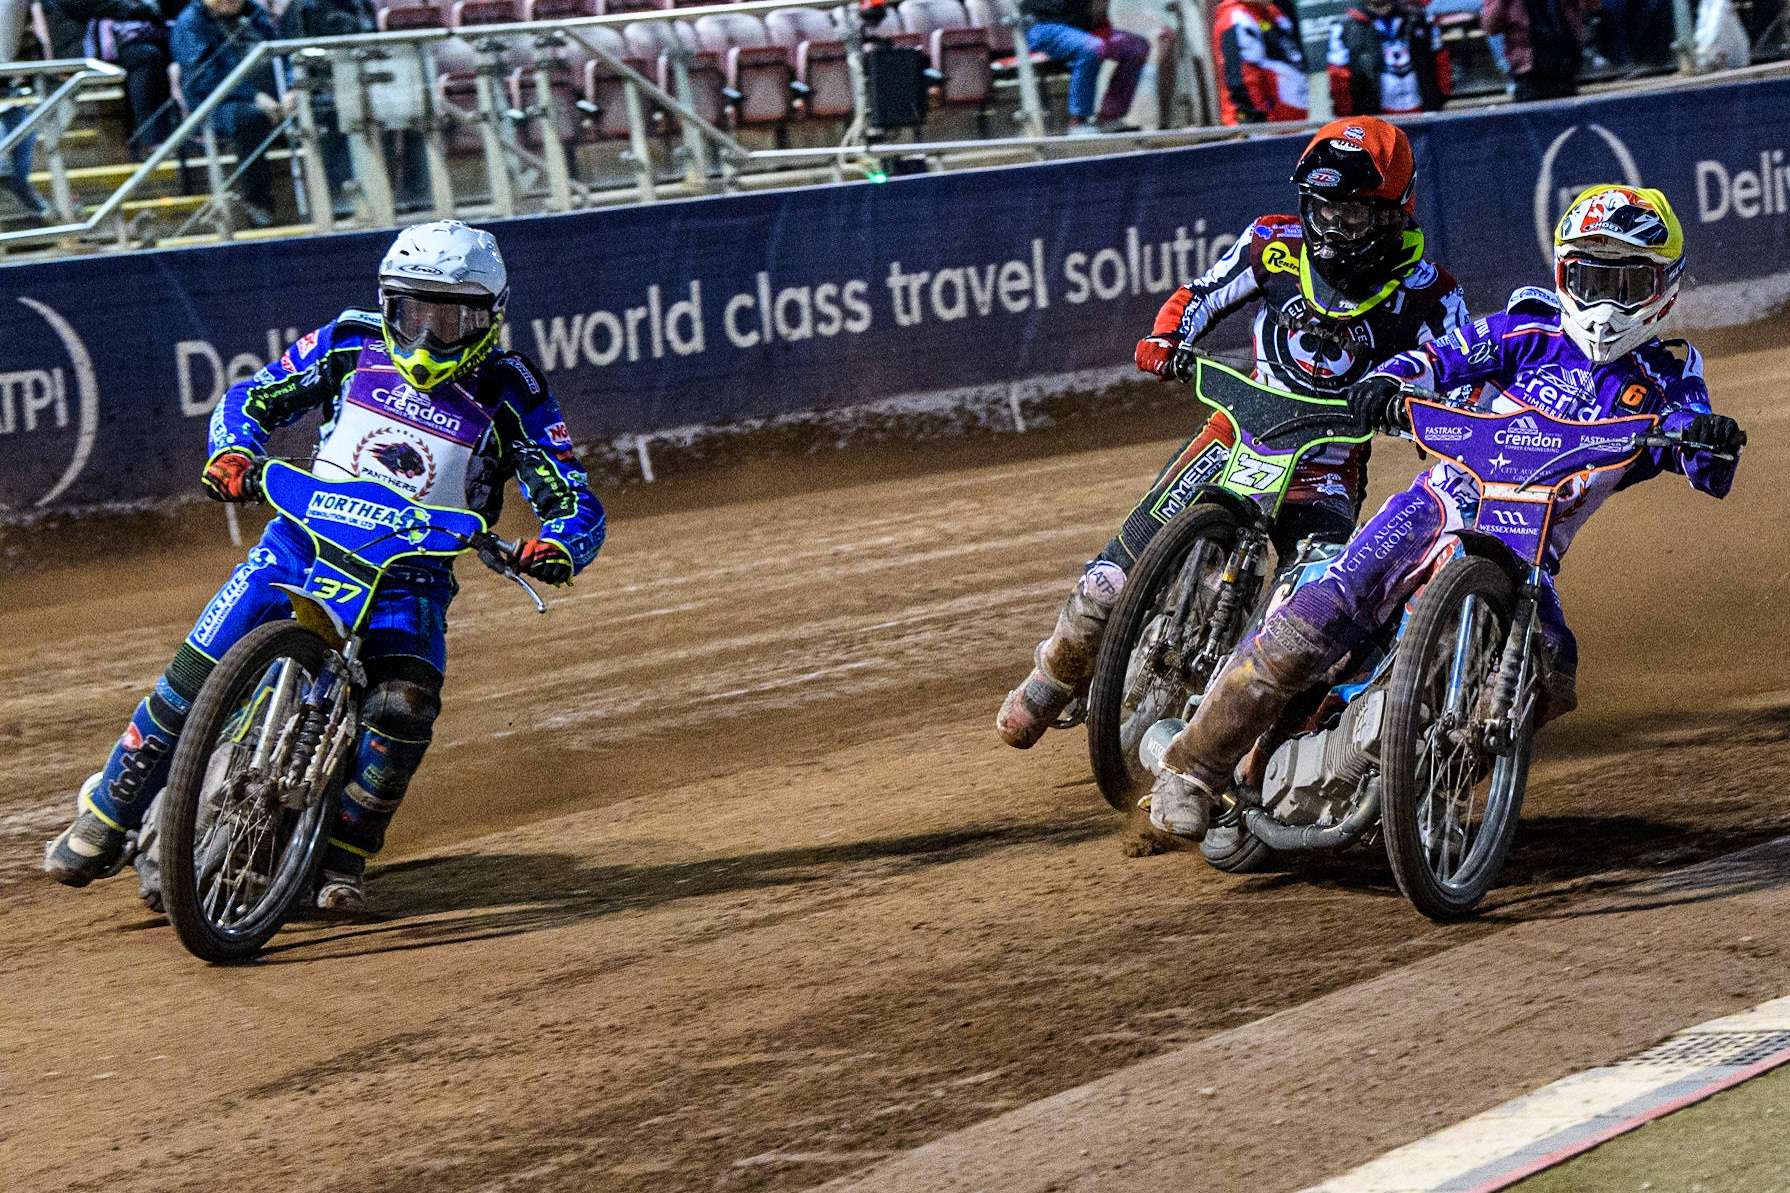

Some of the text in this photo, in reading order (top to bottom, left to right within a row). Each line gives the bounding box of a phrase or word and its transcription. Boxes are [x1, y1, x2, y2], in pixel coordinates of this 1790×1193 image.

[1588, 223, 1619, 232] SHOEI
[531, 281, 705, 371] world
[724, 271, 872, 347] class
[885, 239, 1049, 327] travel
[0, 368, 67, 434] TPI
[1522, 392, 1557, 417] TIMBER
[1621, 384, 1648, 407] 6
[371, 387, 461, 432] Crendon
[1425, 426, 1463, 435] FASTRACK
[1493, 429, 1562, 449] Crendon
[361, 467, 419, 493] PANTHERS
[1228, 453, 1286, 491] 27
[1346, 496, 1426, 574] CITY AUCTION
[1374, 519, 1414, 561] GROUP
[1479, 523, 1539, 536] WESSEX MARINE
[311, 576, 363, 604] 37
